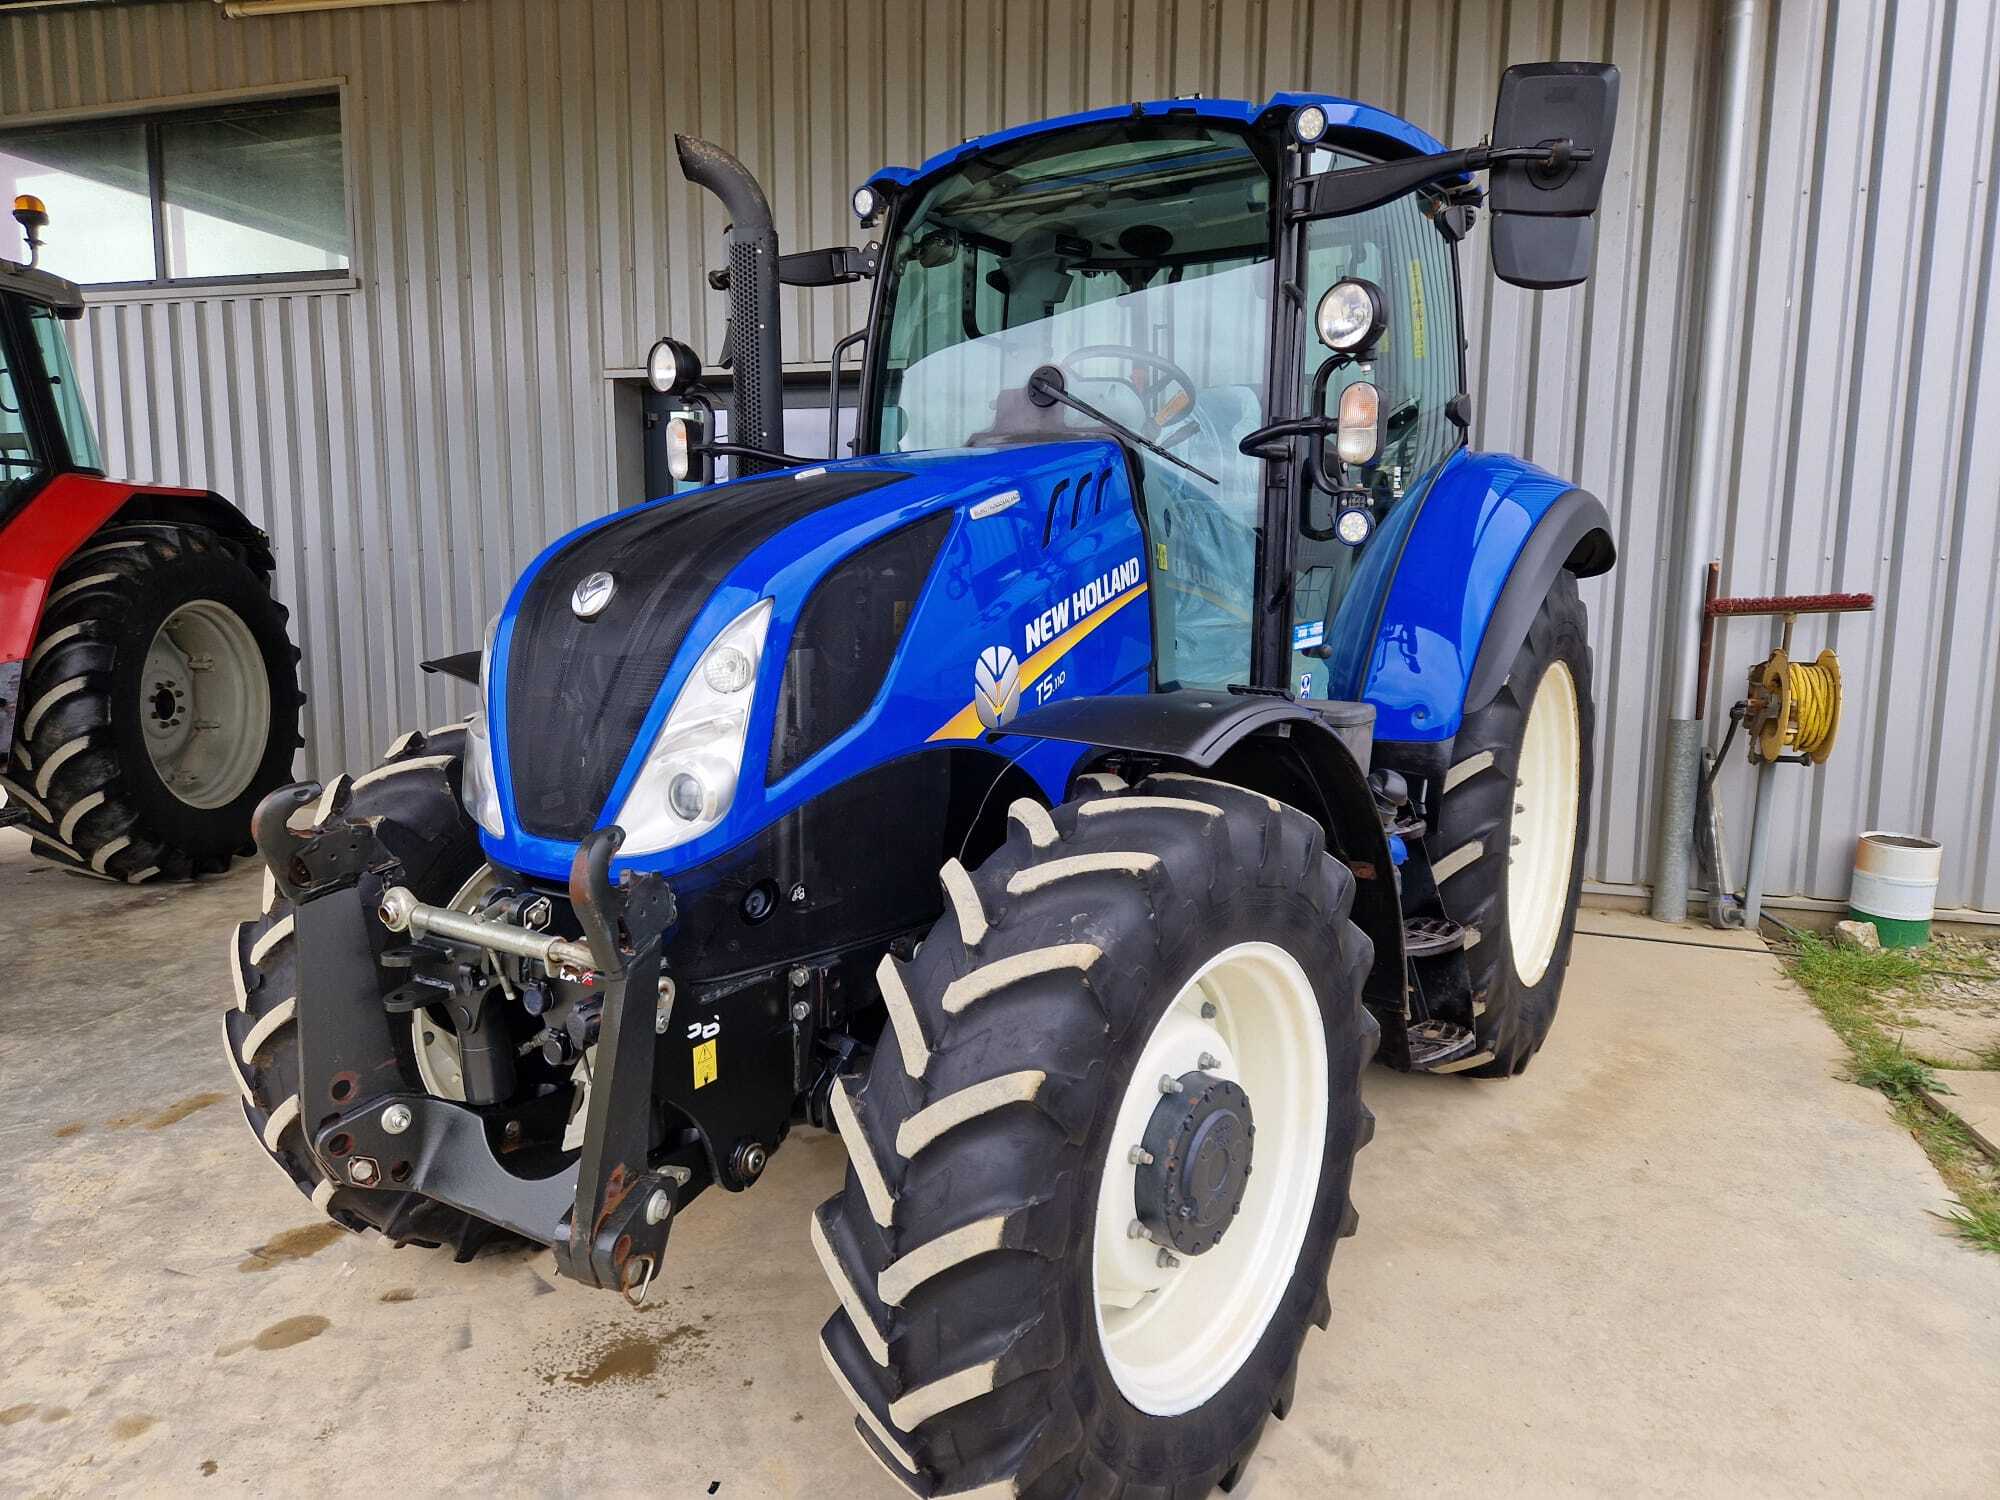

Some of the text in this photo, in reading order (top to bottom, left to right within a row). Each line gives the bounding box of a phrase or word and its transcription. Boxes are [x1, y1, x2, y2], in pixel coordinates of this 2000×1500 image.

[1025, 598, 1070, 653] NEW
[1072, 556, 1140, 621] HOLLAND
[1035, 671, 1066, 706] T5.110
